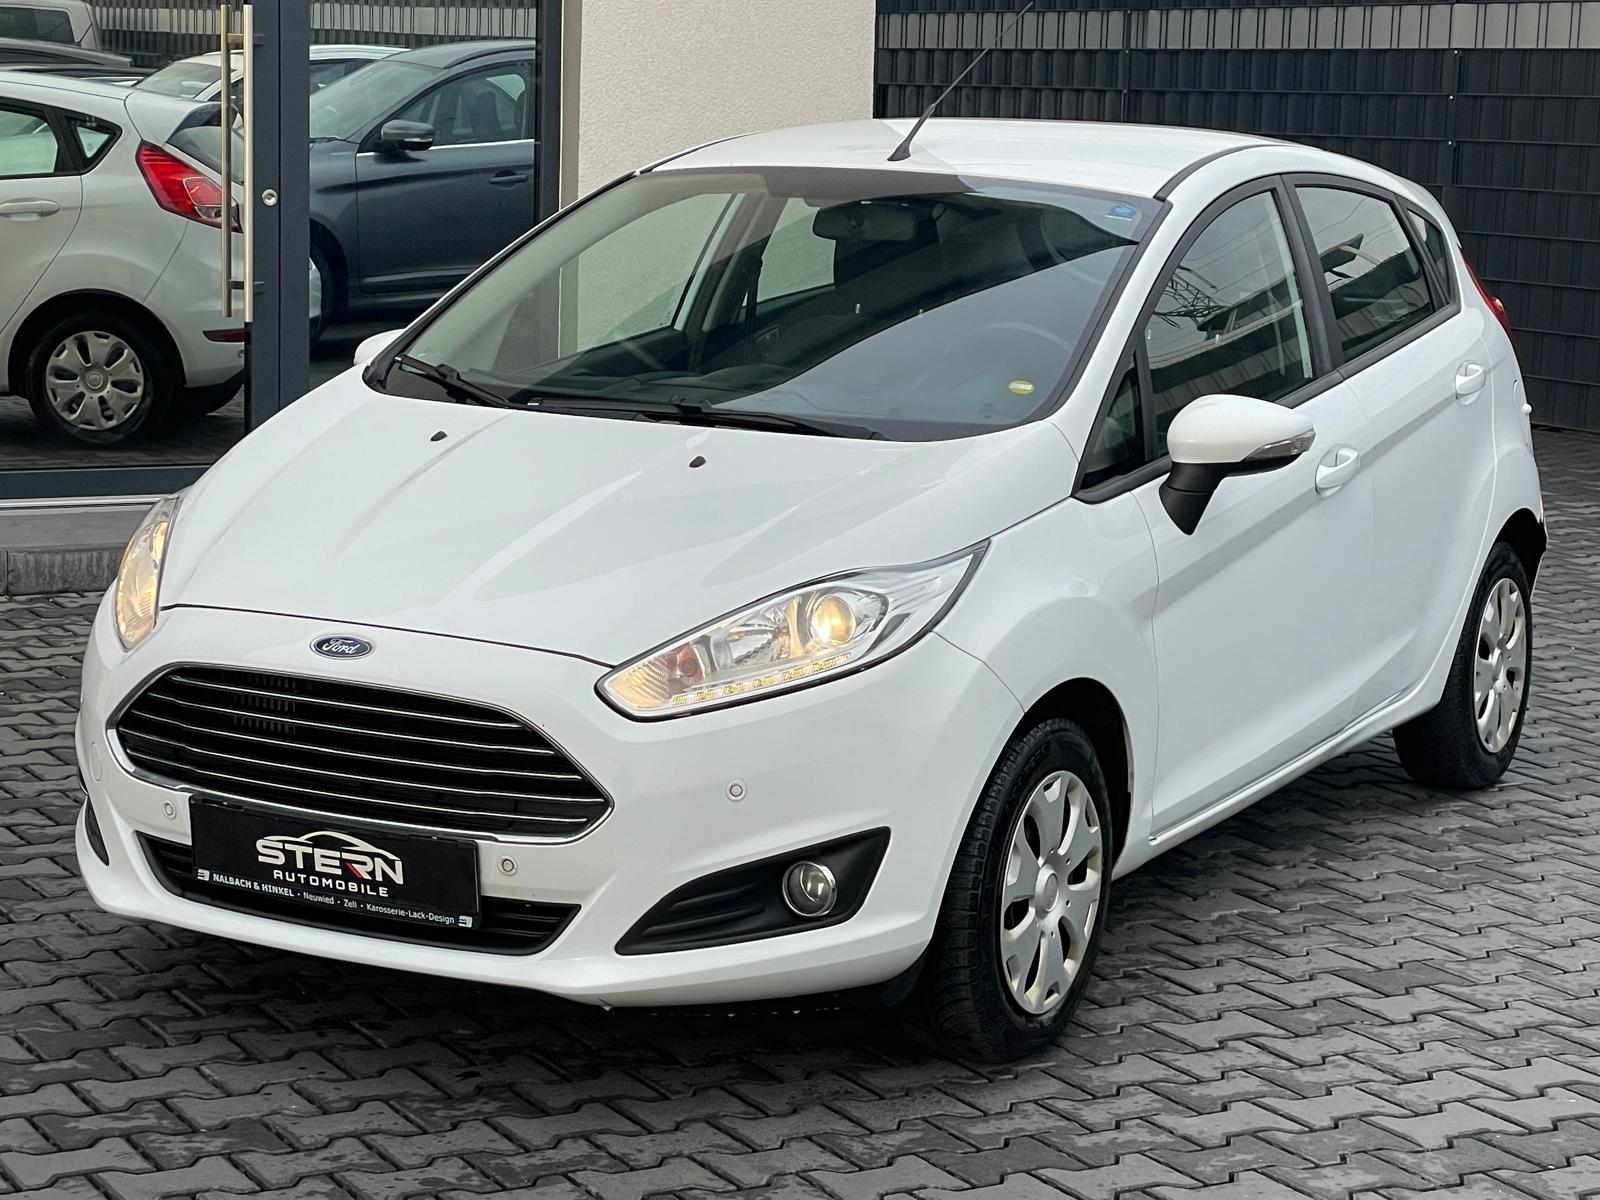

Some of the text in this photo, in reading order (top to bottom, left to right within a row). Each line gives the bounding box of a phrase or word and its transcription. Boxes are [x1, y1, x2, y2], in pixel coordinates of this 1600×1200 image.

[322, 638, 361, 654] Ford
[256, 839, 404, 885] STERN
[213, 873, 455, 925] NALBACH & HINKEL Neuwied Zell Karosserie-Lack-Design
[273, 869, 389, 898] AUTOMOBILE
